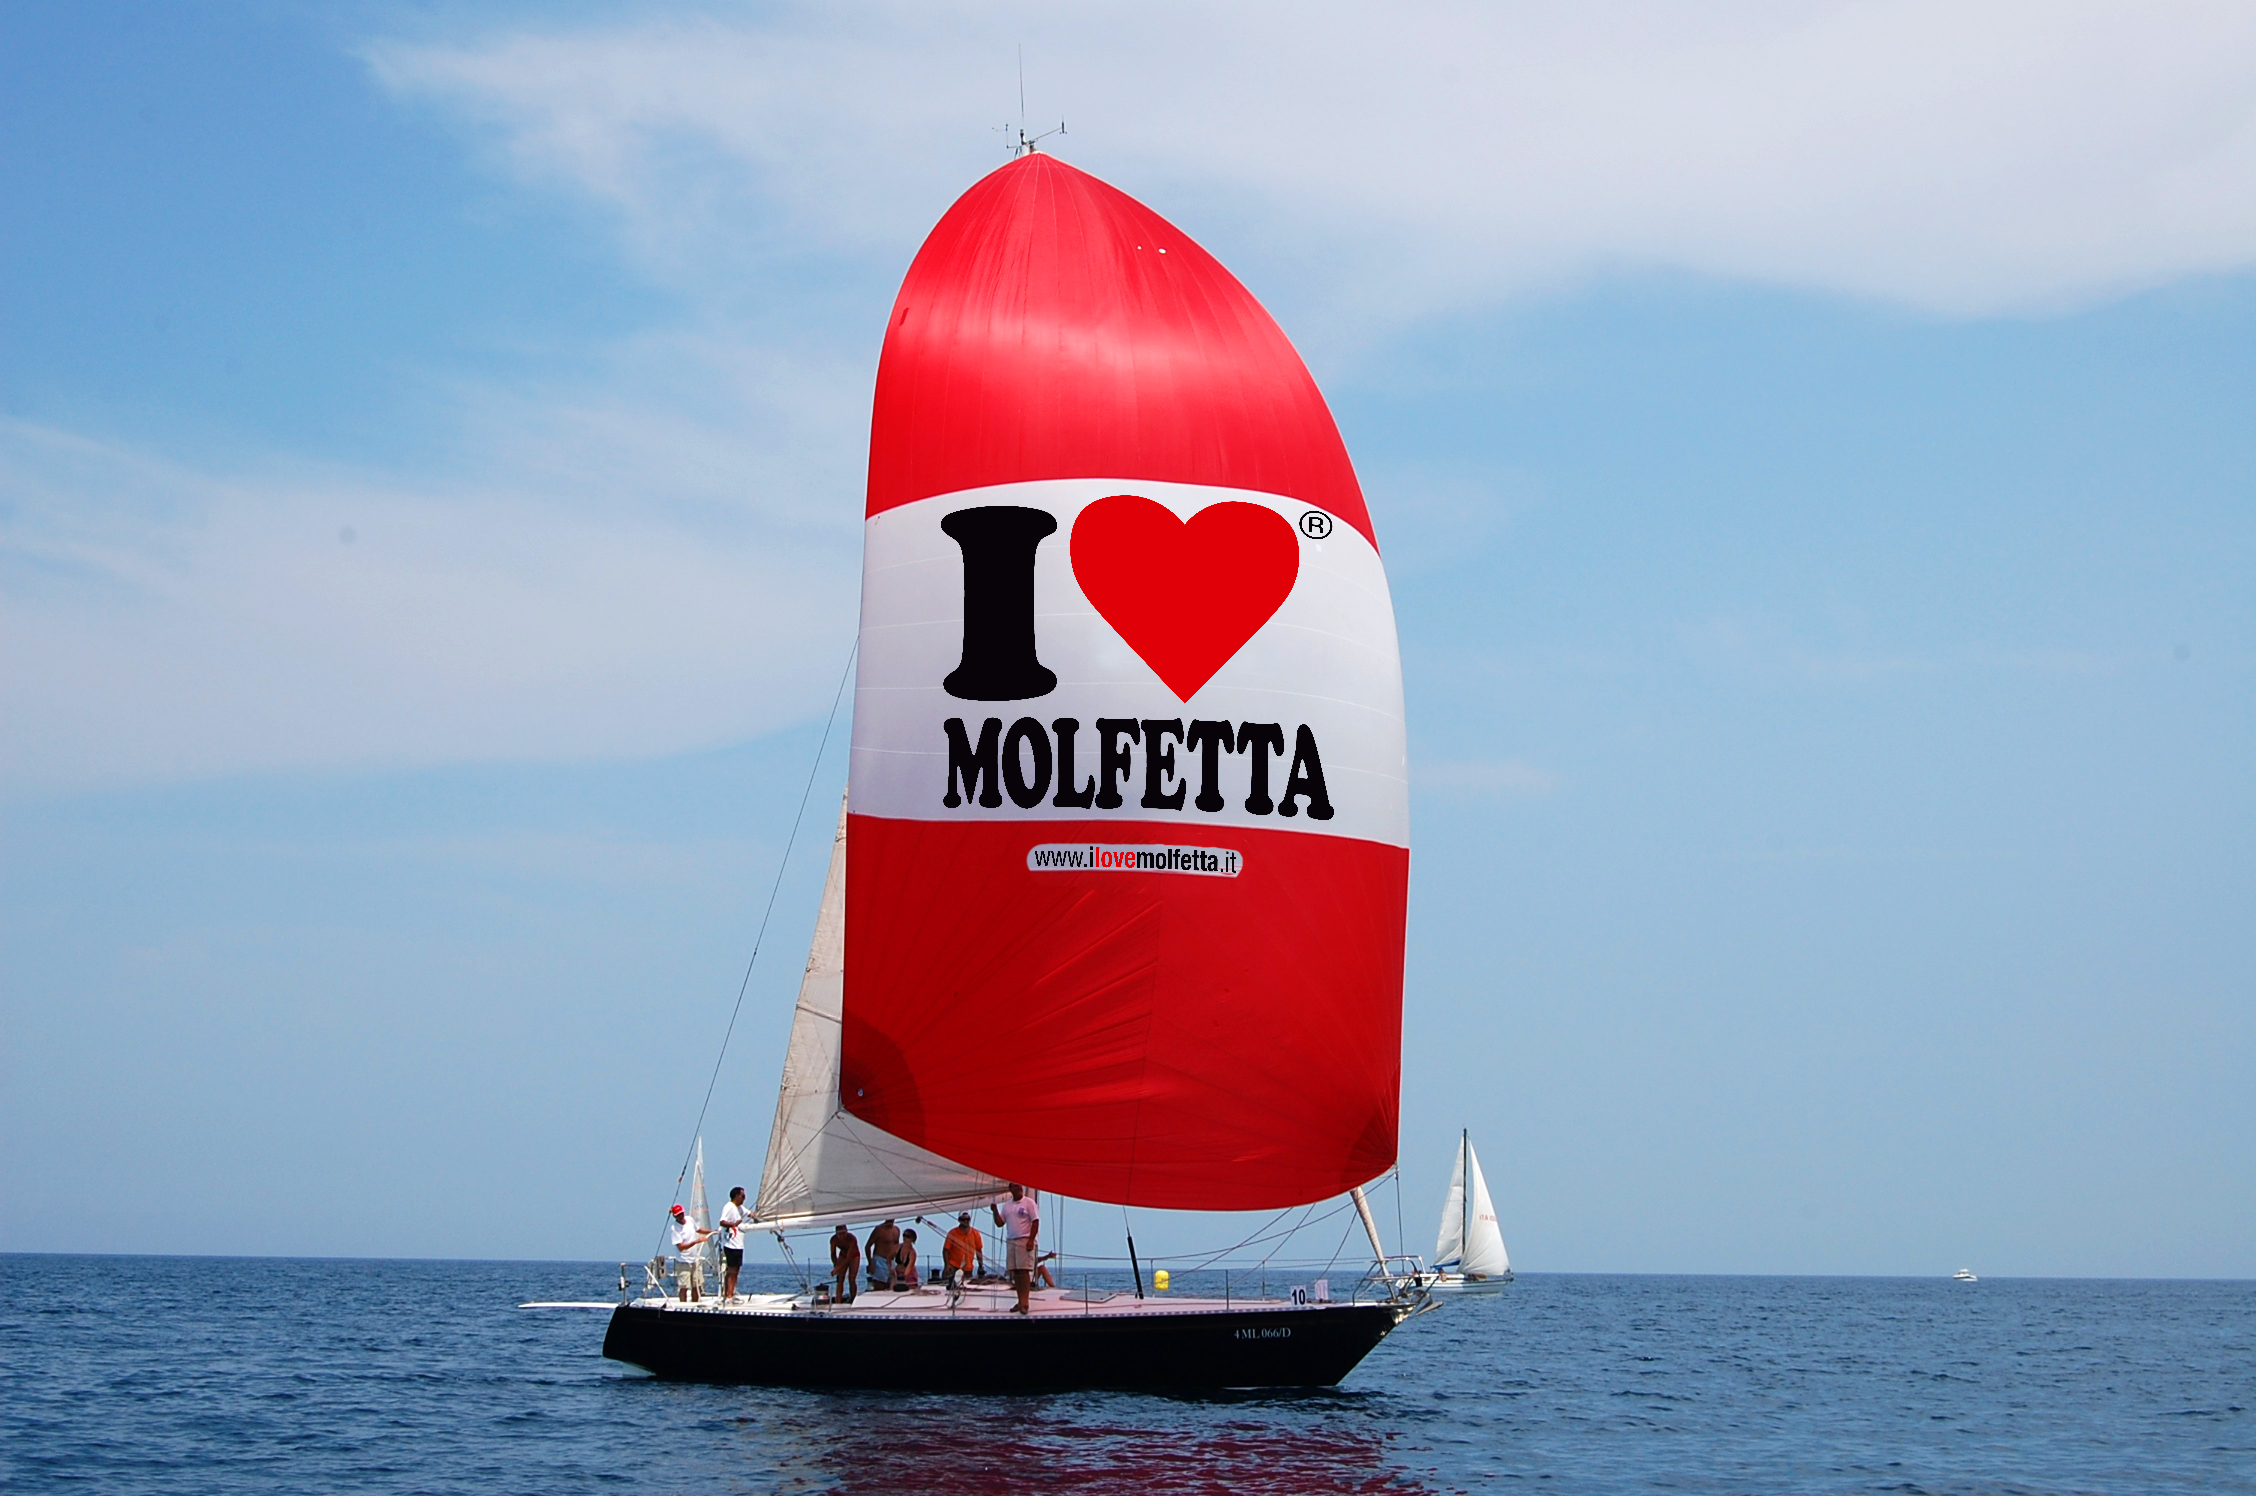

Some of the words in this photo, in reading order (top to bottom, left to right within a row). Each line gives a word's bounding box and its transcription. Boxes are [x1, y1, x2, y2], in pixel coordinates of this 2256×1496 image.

[941, 505, 1058, 702] I
[943, 716, 1335, 821] MOLFETTA
[1034, 846, 1237, 874] www.ilovemolfetta.it
[1291, 1288, 1306, 1306] 10
